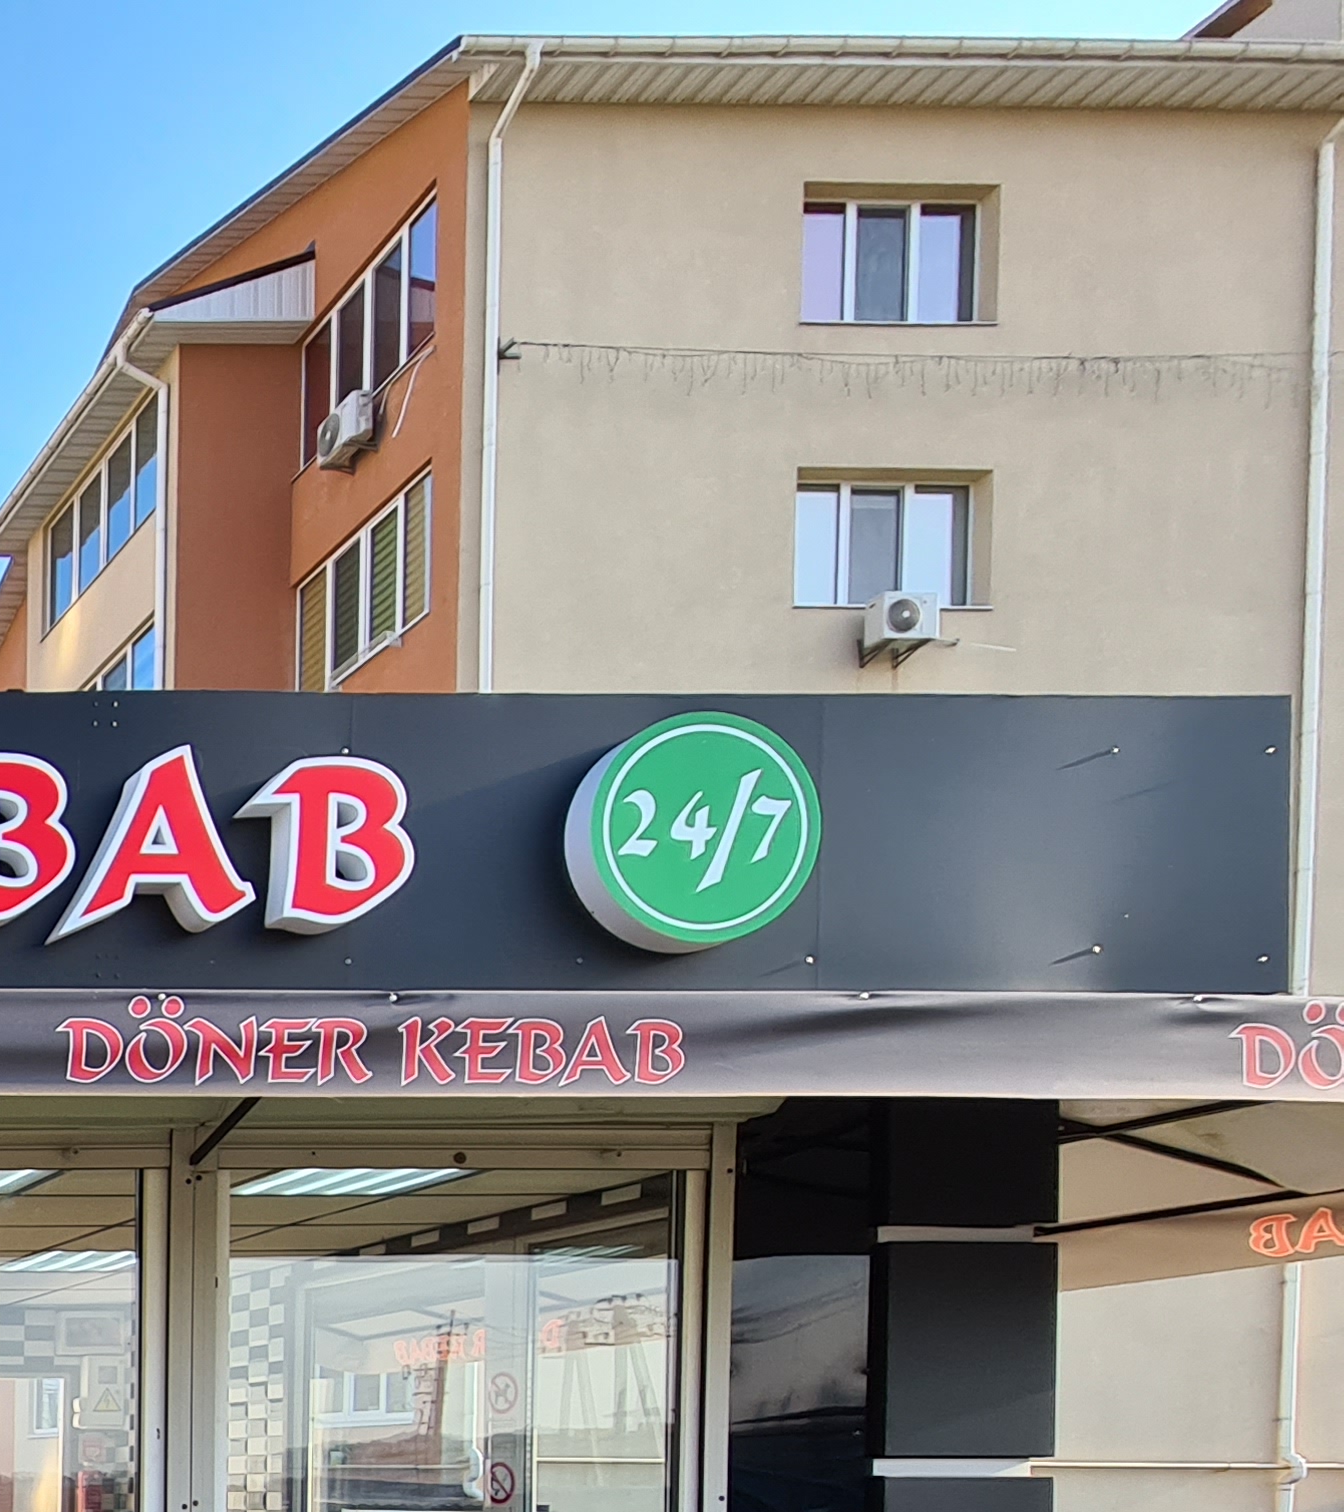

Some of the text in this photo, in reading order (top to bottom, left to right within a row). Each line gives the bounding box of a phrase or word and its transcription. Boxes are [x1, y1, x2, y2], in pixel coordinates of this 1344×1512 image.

[617, 768, 792, 894] 24/7
[55, 995, 686, 1087] DÖNER KEBAB
